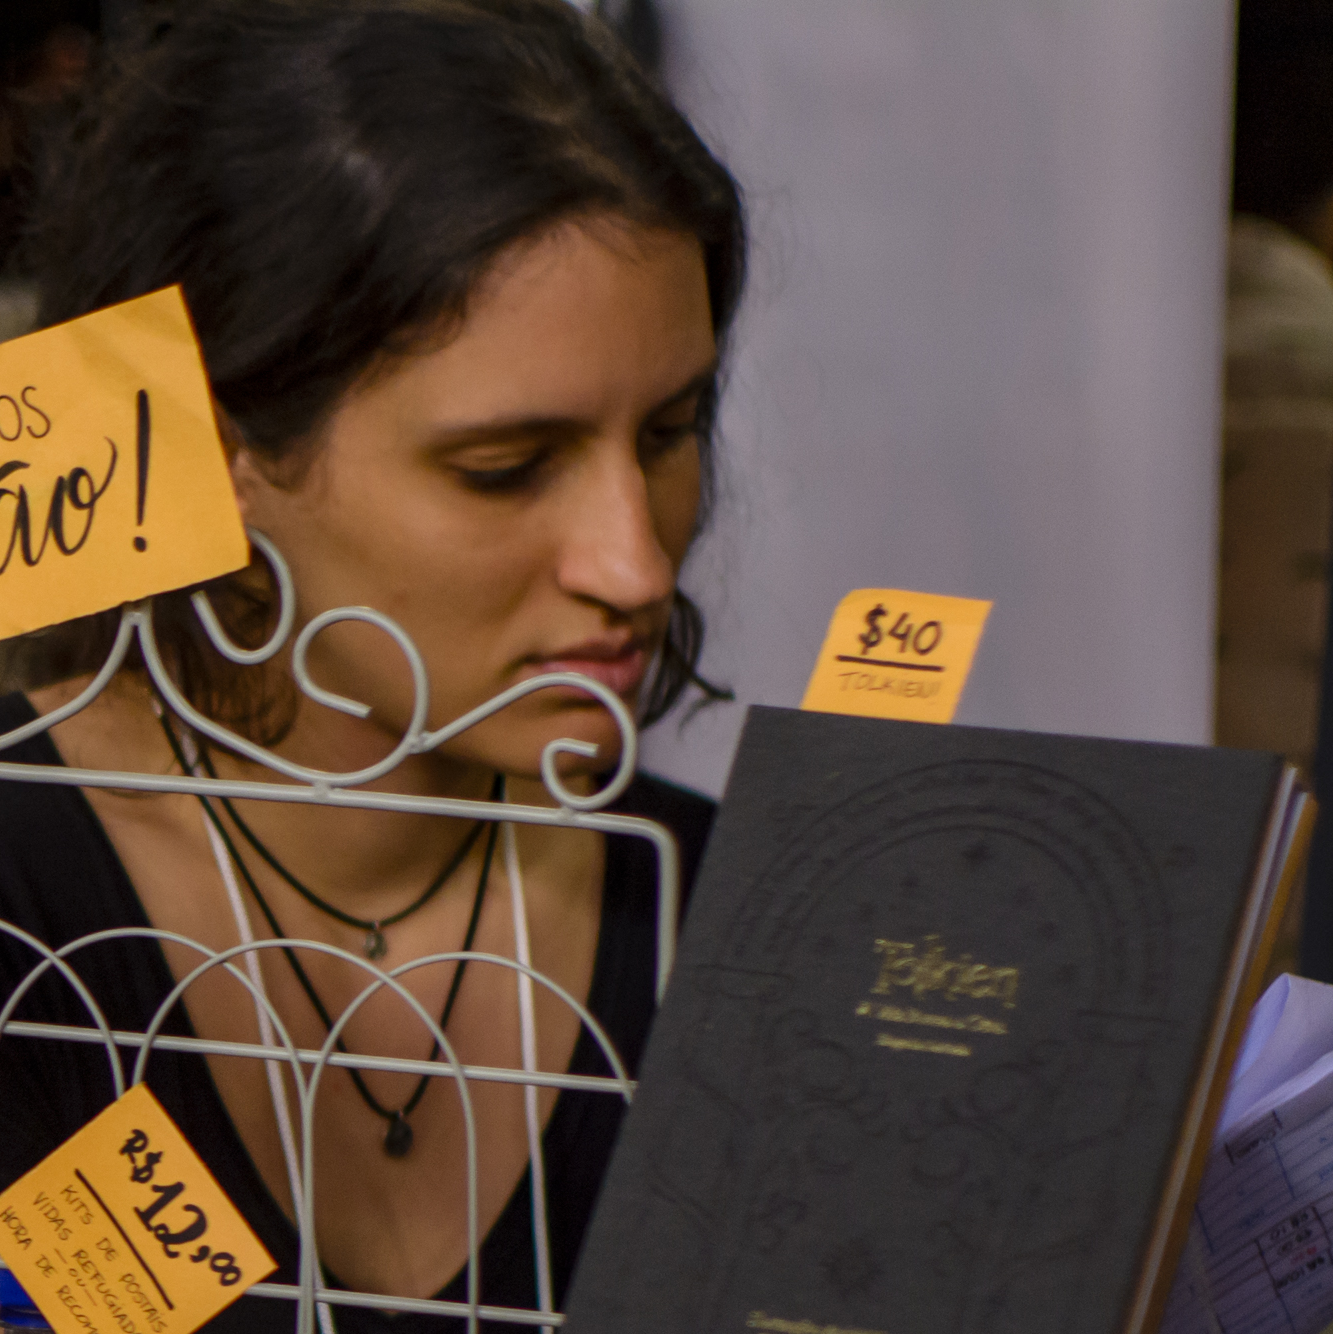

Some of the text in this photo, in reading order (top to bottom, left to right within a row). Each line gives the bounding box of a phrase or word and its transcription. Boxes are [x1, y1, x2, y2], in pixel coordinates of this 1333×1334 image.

[859, 603, 944, 656] $40
[32, 1191, 73, 1241] VIDAS
[35, 1254, 58, 1278] DE
[60, 1184, 169, 1334] KITS DE POSTAIS
